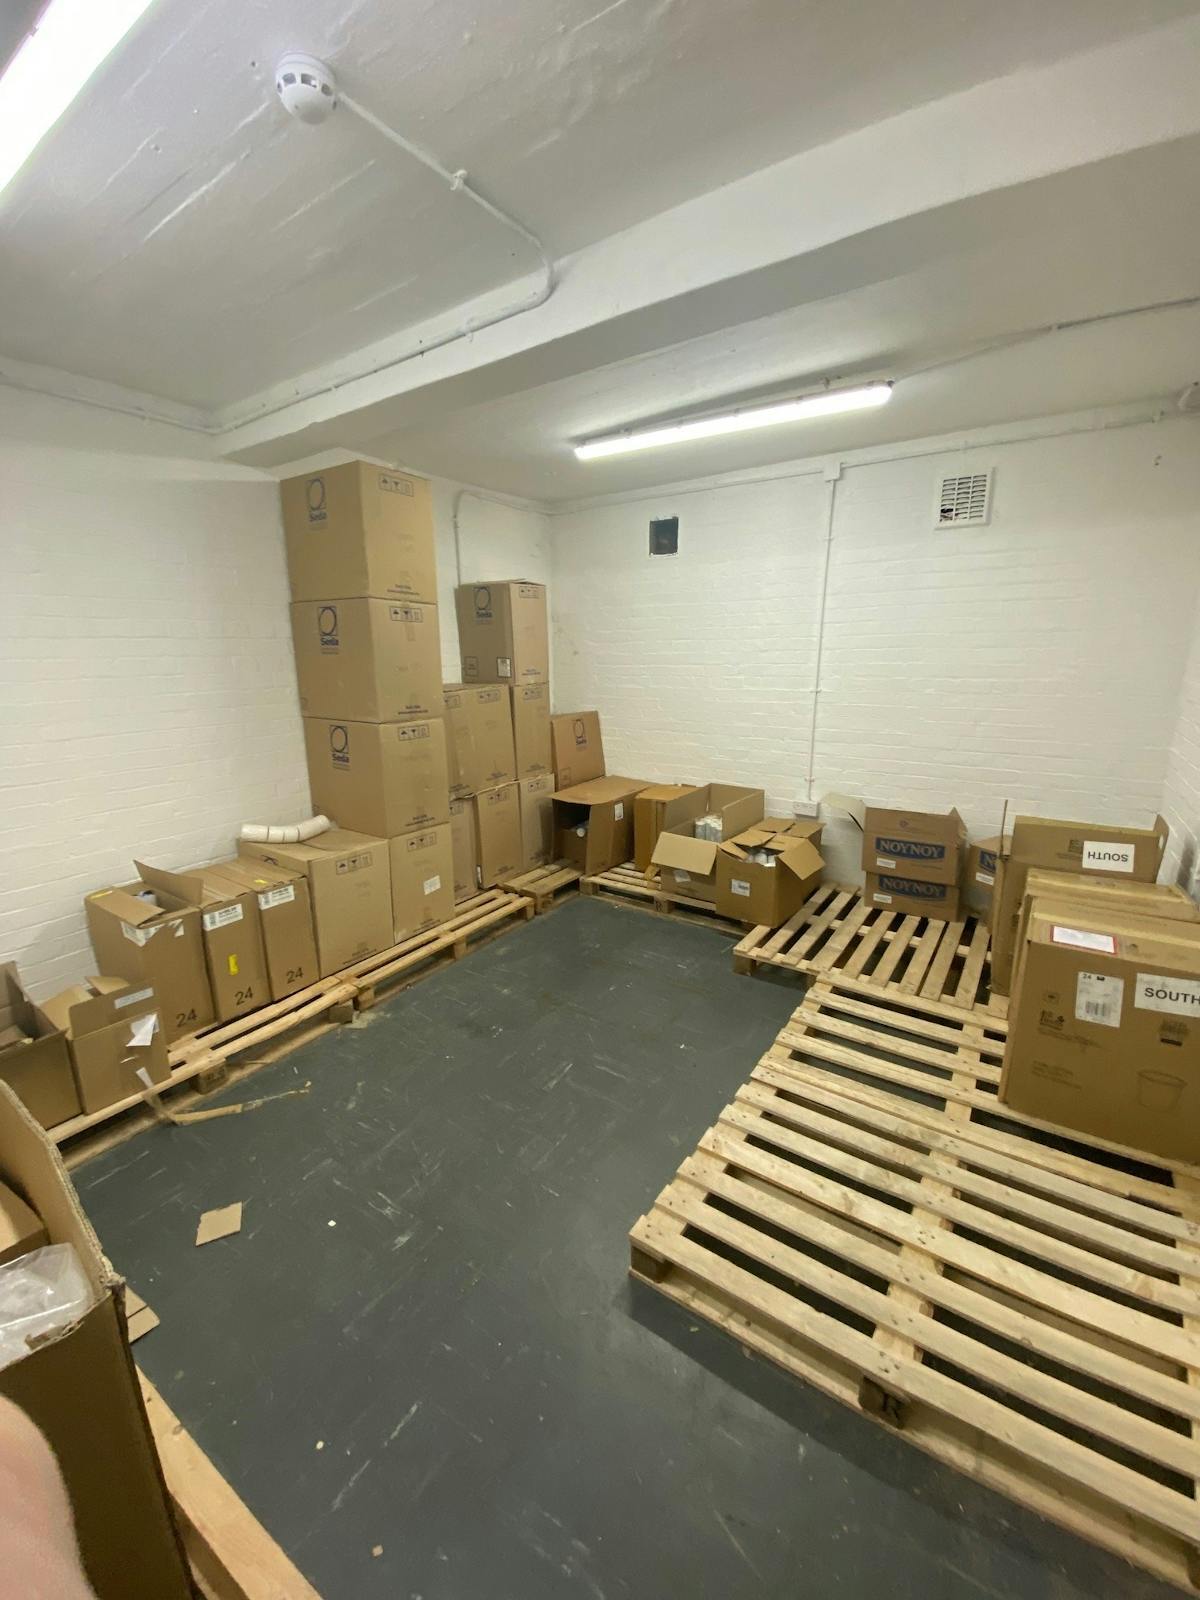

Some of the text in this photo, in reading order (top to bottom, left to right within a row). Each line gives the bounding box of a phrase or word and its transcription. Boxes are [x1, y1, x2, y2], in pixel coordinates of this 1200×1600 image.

[321, 637, 339, 647] Seda
[879, 840, 941, 859] NOYNOY
[1087, 851, 1129, 863] SOUTH
[882, 879, 944, 897] NOYNOY
[286, 968, 304, 985] 24
[234, 986, 253, 1006] 24
[1144, 987, 1200, 1006] SOUTH
[176, 1009, 198, 1028] 24
